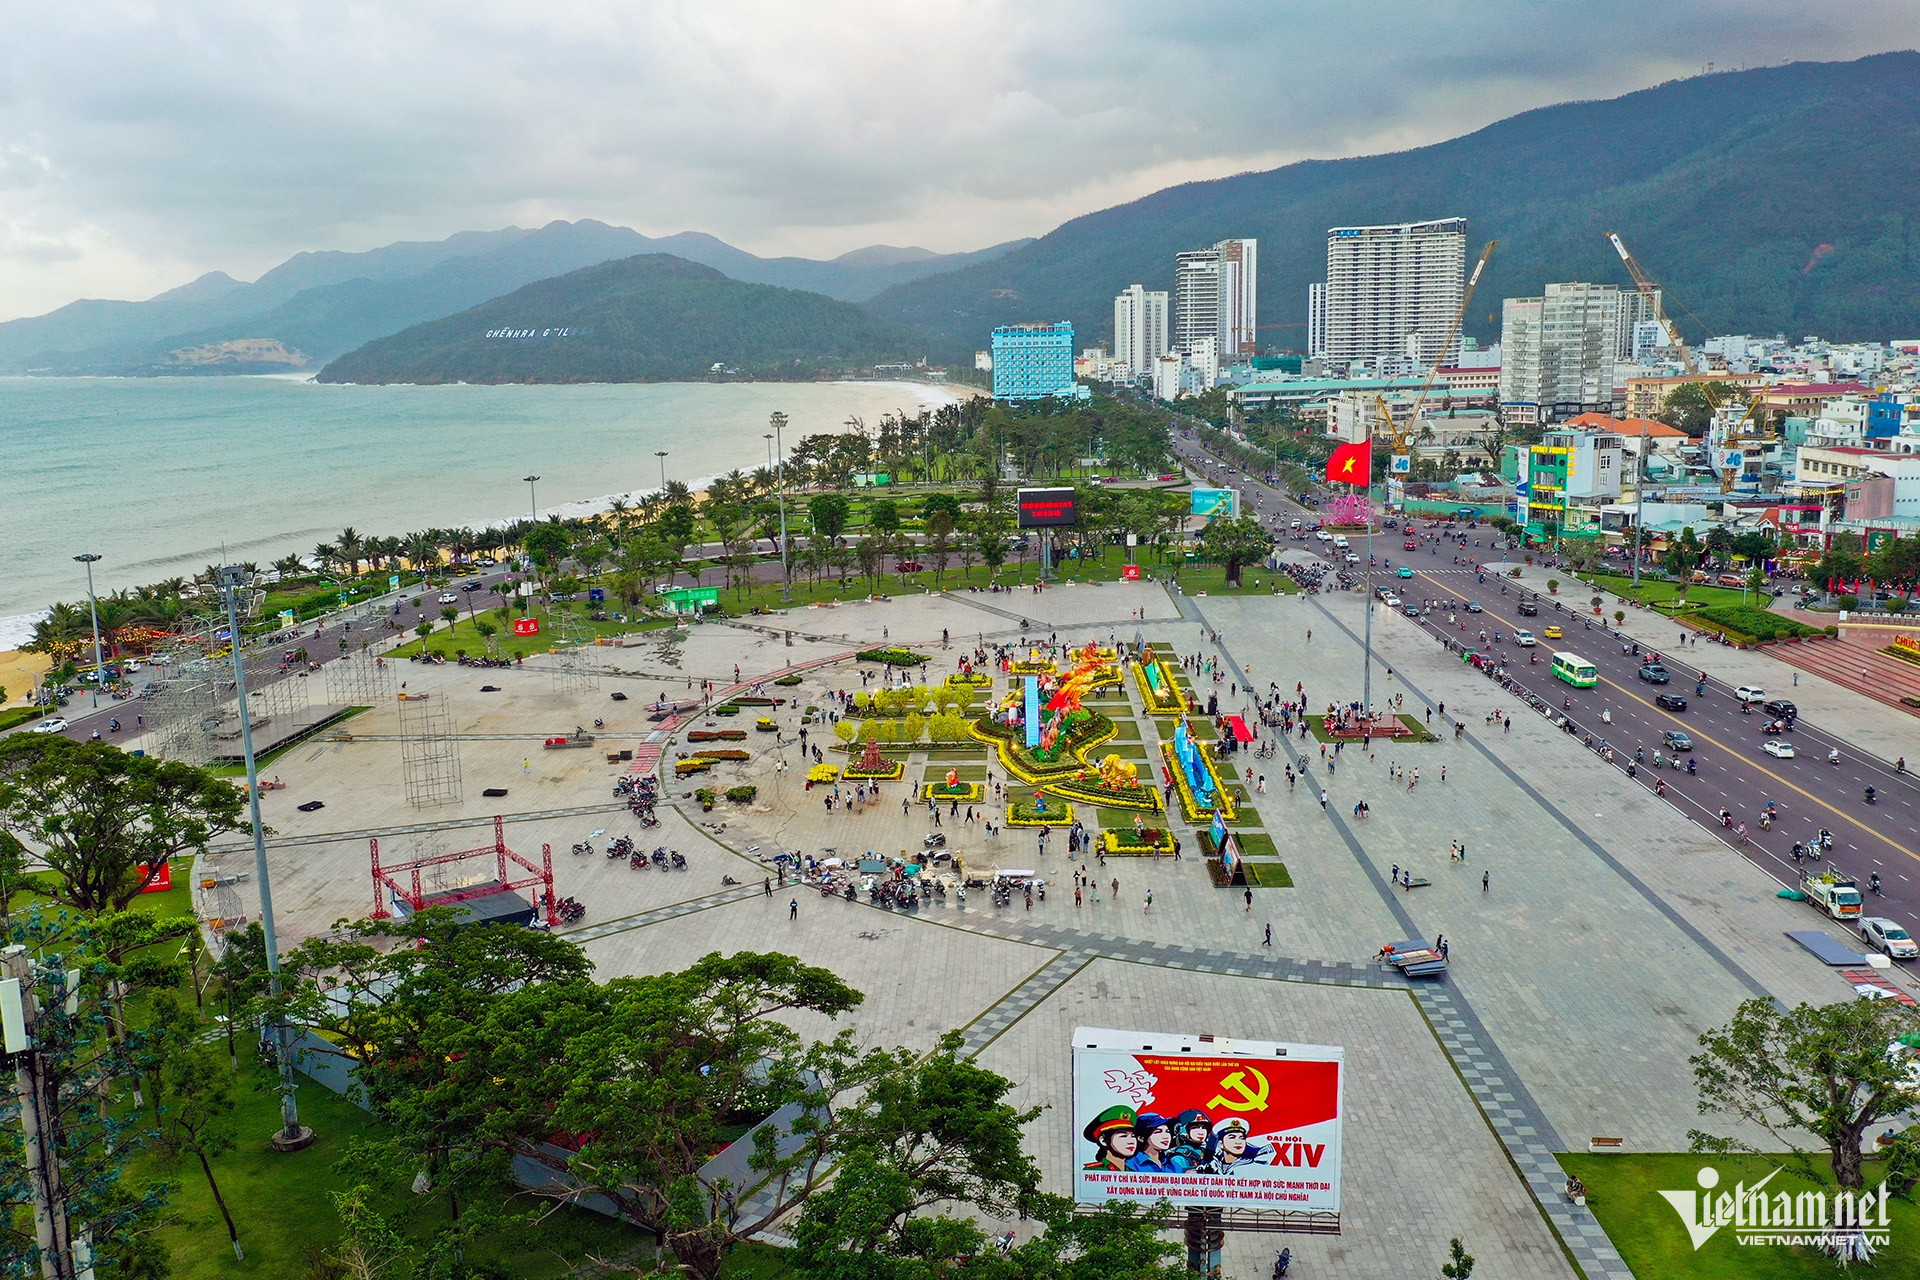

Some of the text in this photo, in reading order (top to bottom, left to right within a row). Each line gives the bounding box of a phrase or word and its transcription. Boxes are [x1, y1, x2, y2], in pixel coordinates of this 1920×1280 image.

[1269, 1142, 1326, 1168] XIV
[1084, 1173, 1099, 1181] PHÁT
[1130, 1174, 1137, 1182] VÀ
[1138, 1174, 1150, 1183] SỨC
[1152, 1176, 1169, 1185] MẠNH
[1170, 1176, 1180, 1186] ĐẠI
[1181, 1176, 1198, 1184] ĐOÀN
[1199, 1176, 1210, 1185] KẾT
[1211, 1177, 1223, 1186] DÂN
[1224, 1177, 1236, 1187] TỘC
[1237, 1177, 1247, 1187] KẾT
[1249, 1179, 1260, 1189] HỢP
[1262, 1179, 1272, 1188] VỚI
[1273, 1179, 1285, 1188] SỨC
[1287, 1182, 1304, 1191] MẠNH
[1306, 1180, 1319, 1190] THỜI
[1320, 1182, 1330, 1192] ĐẠI
[1106, 1185, 1118, 1194] XÂY
[1119, 1187, 1135, 1195] DỰNG
[1136, 1186, 1144, 1195] VÀ
[1145, 1185, 1157, 1195] BẢO
[1166, 1187, 1182, 1196] VỮNG
[1209, 1188, 1225, 1198] QUỐC
[1226, 1189, 1238, 1200] VIỆT
[1264, 1191, 1274, 1201] HỘI
[1275, 1190, 1287, 1201] CHỦ
